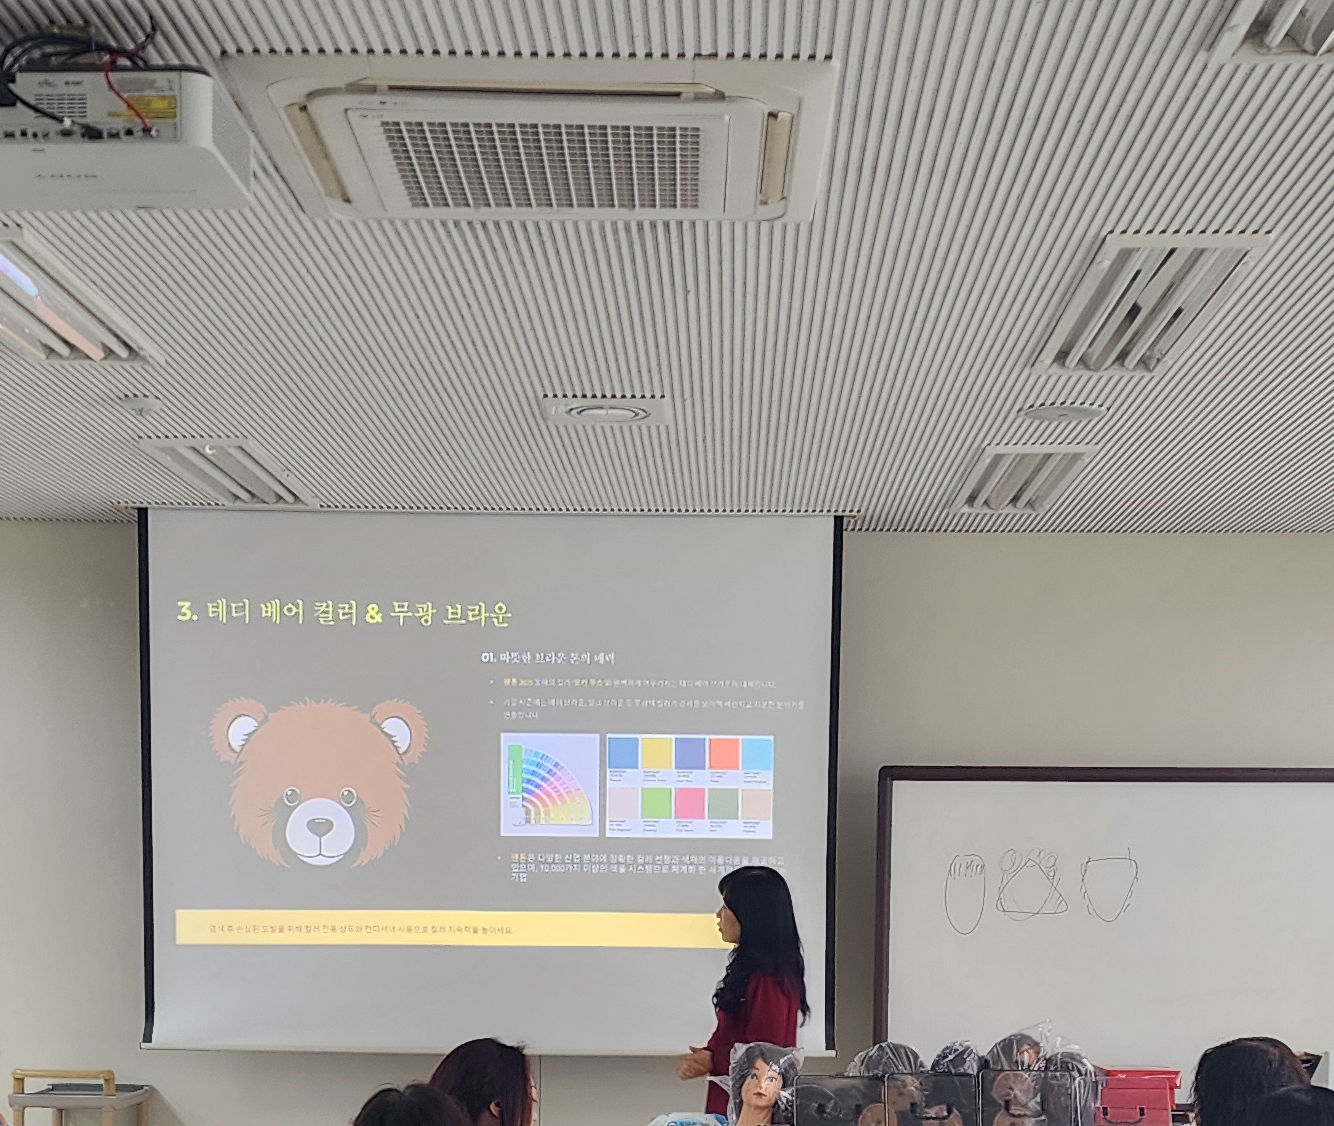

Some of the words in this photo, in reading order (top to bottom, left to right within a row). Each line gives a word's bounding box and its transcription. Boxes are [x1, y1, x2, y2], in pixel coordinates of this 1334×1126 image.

[176, 600, 199, 621] 3.
[207, 598, 251, 624] 테디
[260, 598, 305, 625] 베어
[314, 600, 358, 626] 컬러
[365, 603, 383, 624] &
[390, 600, 437, 627] 무광
[443, 601, 512, 628] 브라운
[481, 652, 497, 663] 01.
[499, 651, 532, 664] 따뜻한
[534, 652, 566, 664] 브라운
